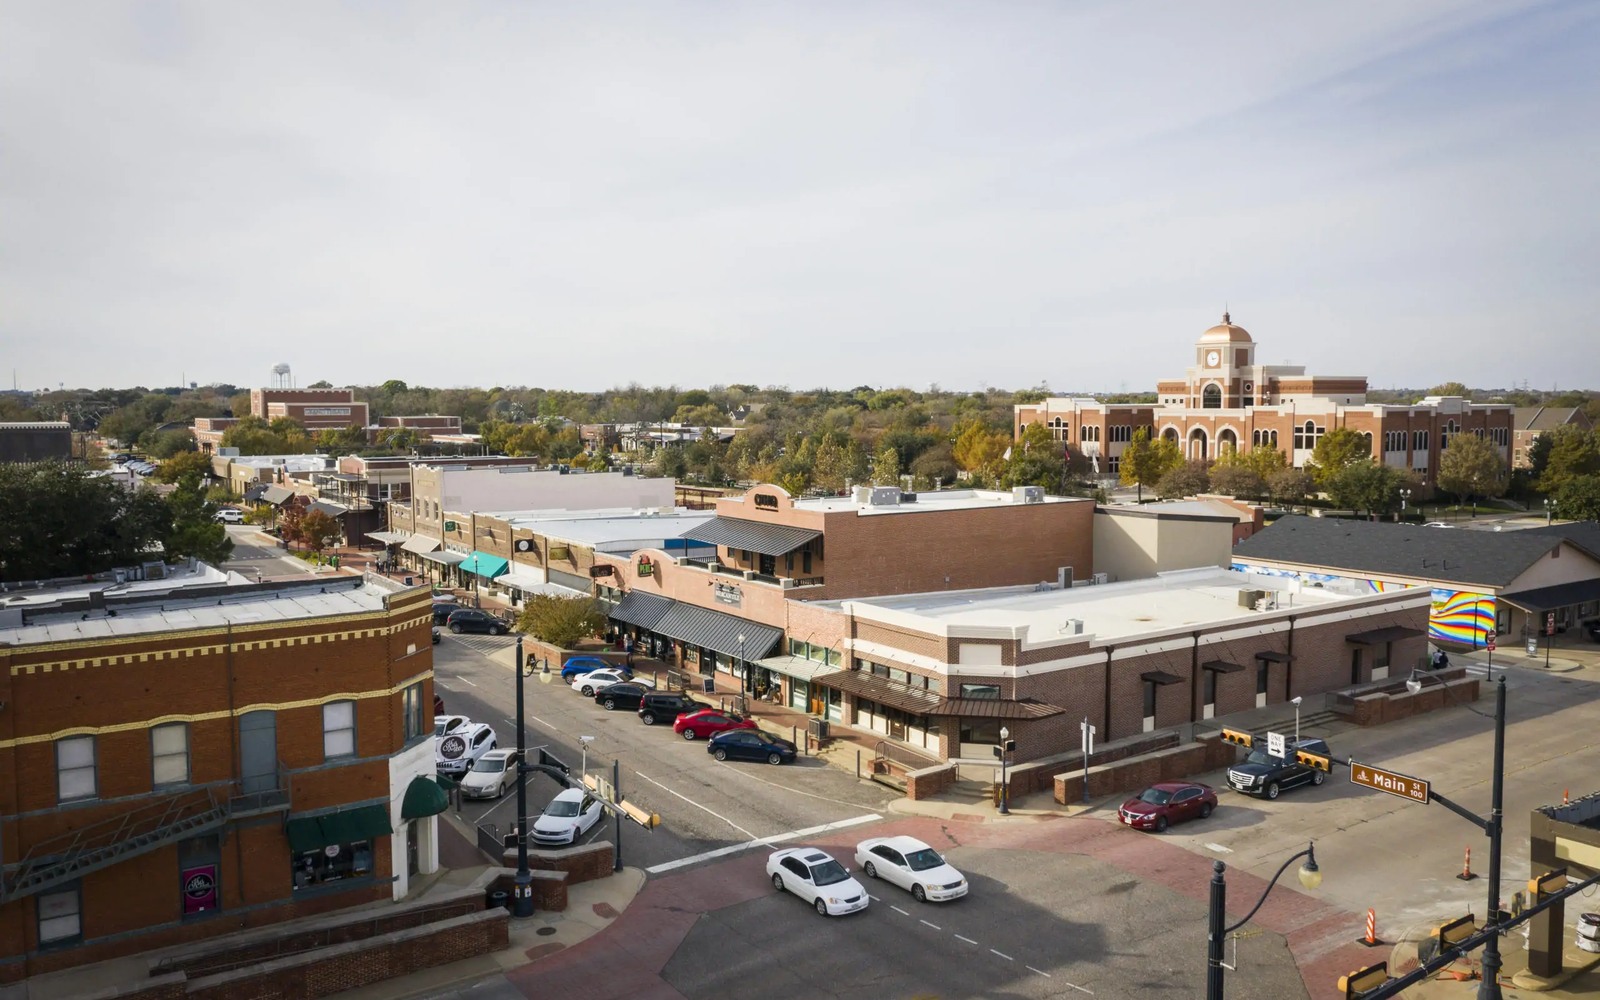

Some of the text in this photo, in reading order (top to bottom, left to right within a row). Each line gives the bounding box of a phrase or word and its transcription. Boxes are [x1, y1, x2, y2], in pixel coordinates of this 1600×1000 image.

[1270, 734, 1282, 742] ONE
[1374, 773, 1405, 792] Main
[1410, 789, 1423, 799] 100
